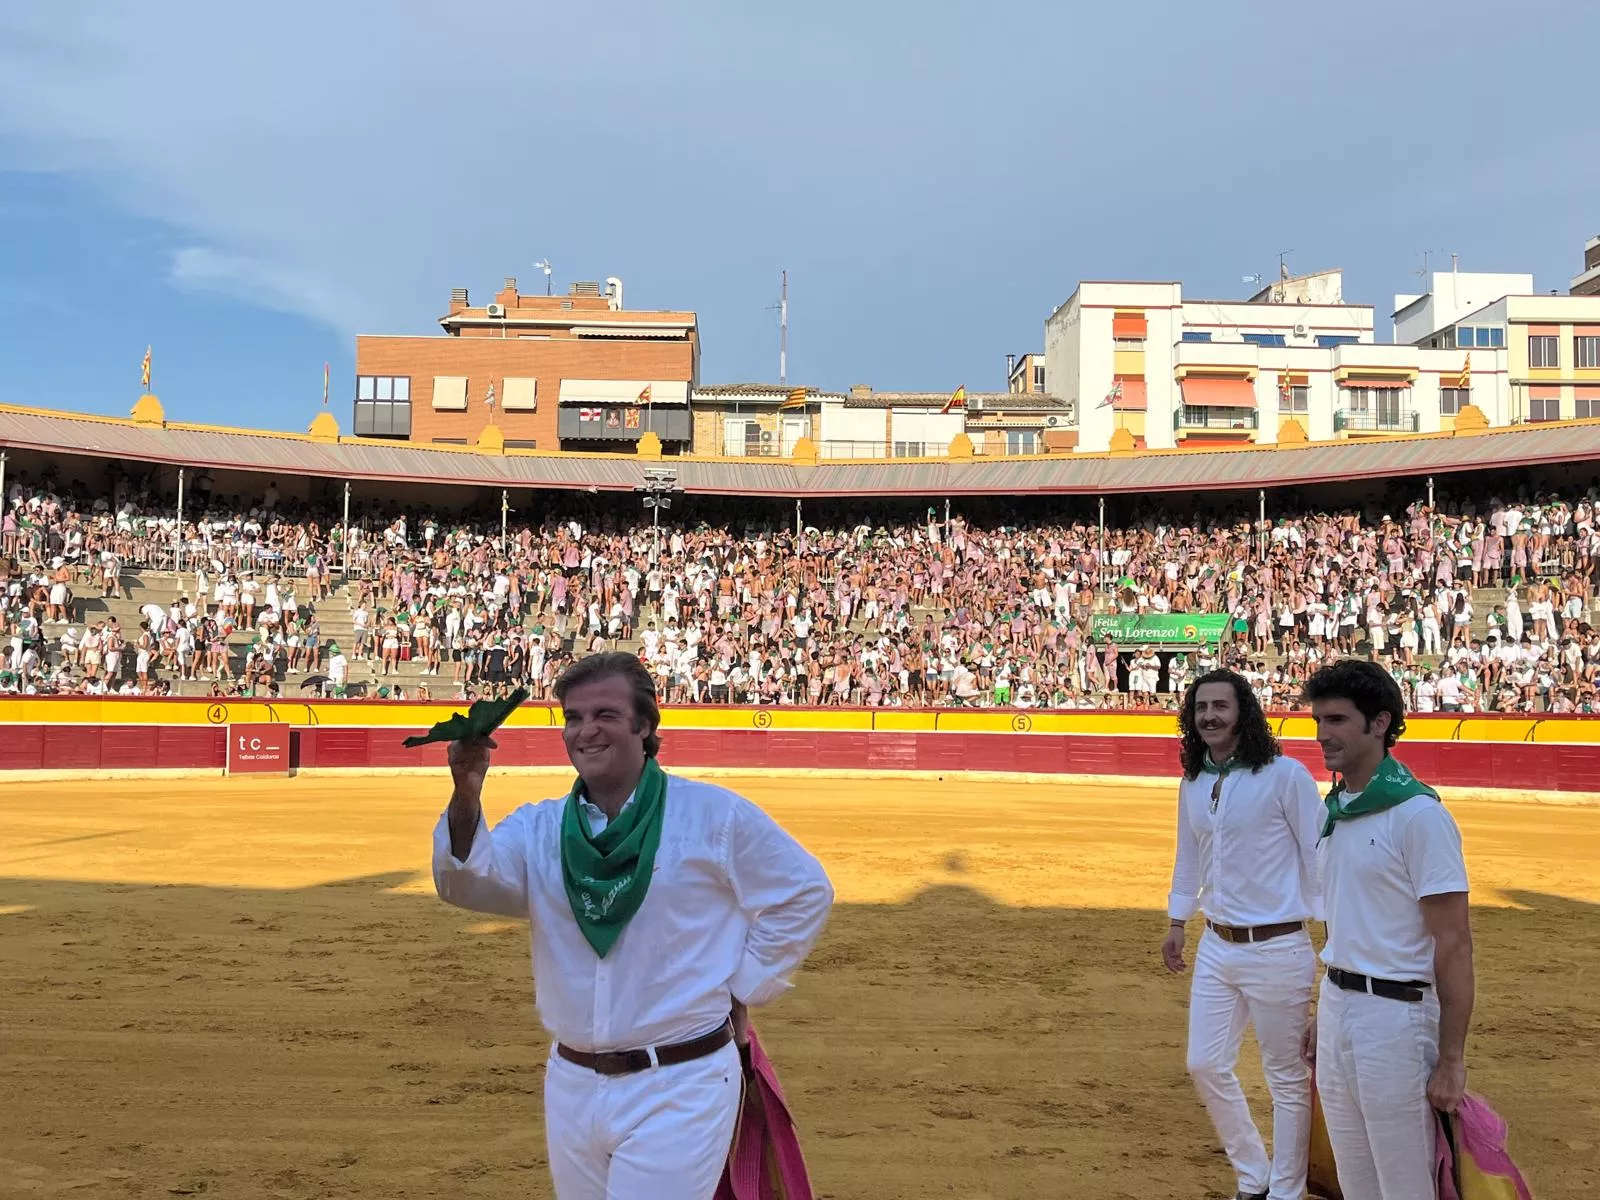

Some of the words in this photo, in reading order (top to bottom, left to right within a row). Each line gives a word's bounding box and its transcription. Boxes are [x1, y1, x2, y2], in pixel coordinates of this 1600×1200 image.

[1095, 618, 1118, 628] ¡Feliz
[1099, 627, 1122, 638] San
[1126, 626, 1179, 638] Lorenzo!
[213, 707, 220, 720] 4
[758, 713, 767, 726] 5
[1017, 718, 1026, 730] 5
